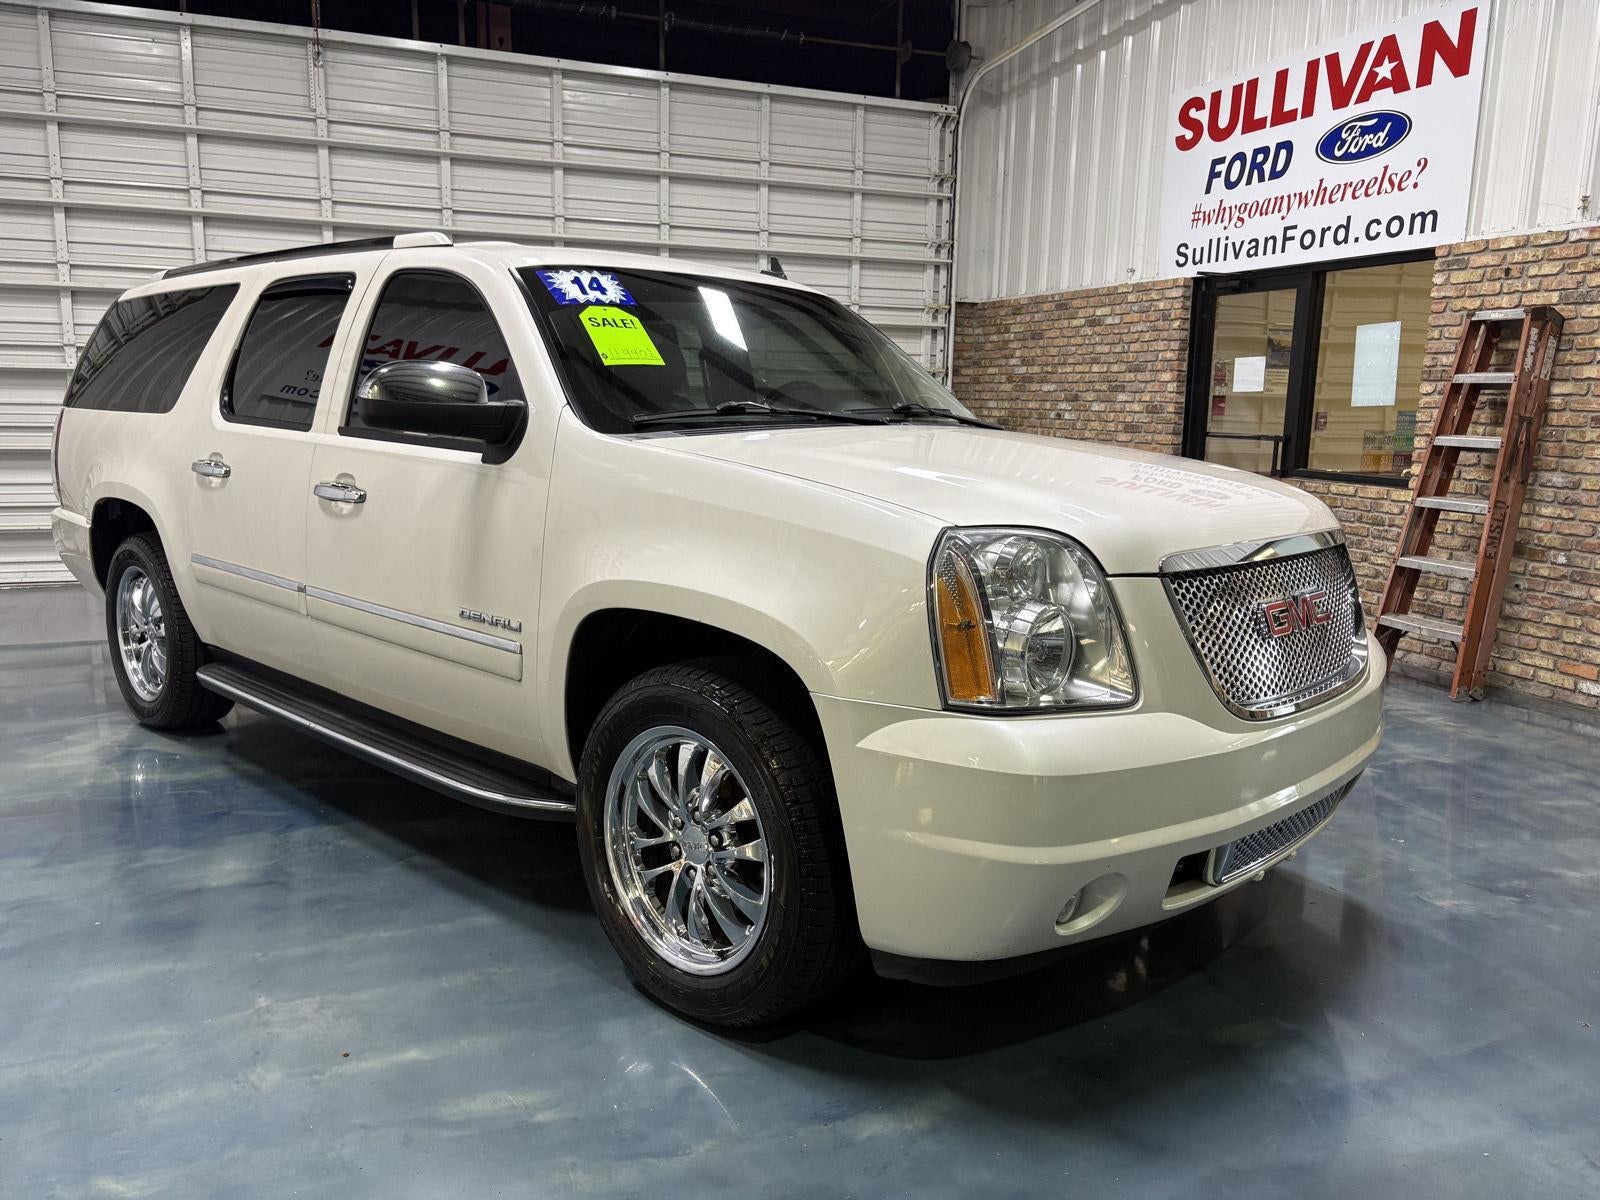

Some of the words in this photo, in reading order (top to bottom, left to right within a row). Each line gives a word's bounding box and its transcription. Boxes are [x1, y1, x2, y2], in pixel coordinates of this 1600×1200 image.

[1175, 6, 1478, 152] SULLIVAN
[1334, 119, 1389, 157] Ford
[1204, 139, 1294, 194] FORD
[1190, 157, 1428, 230] #whygoanywhereelse?
[1175, 208, 1439, 268] SullivanFord.com
[570, 276, 608, 295] 14
[588, 317, 638, 330] SALE!
[458, 606, 522, 633] DENALI
[1265, 590, 1332, 638] GMC
